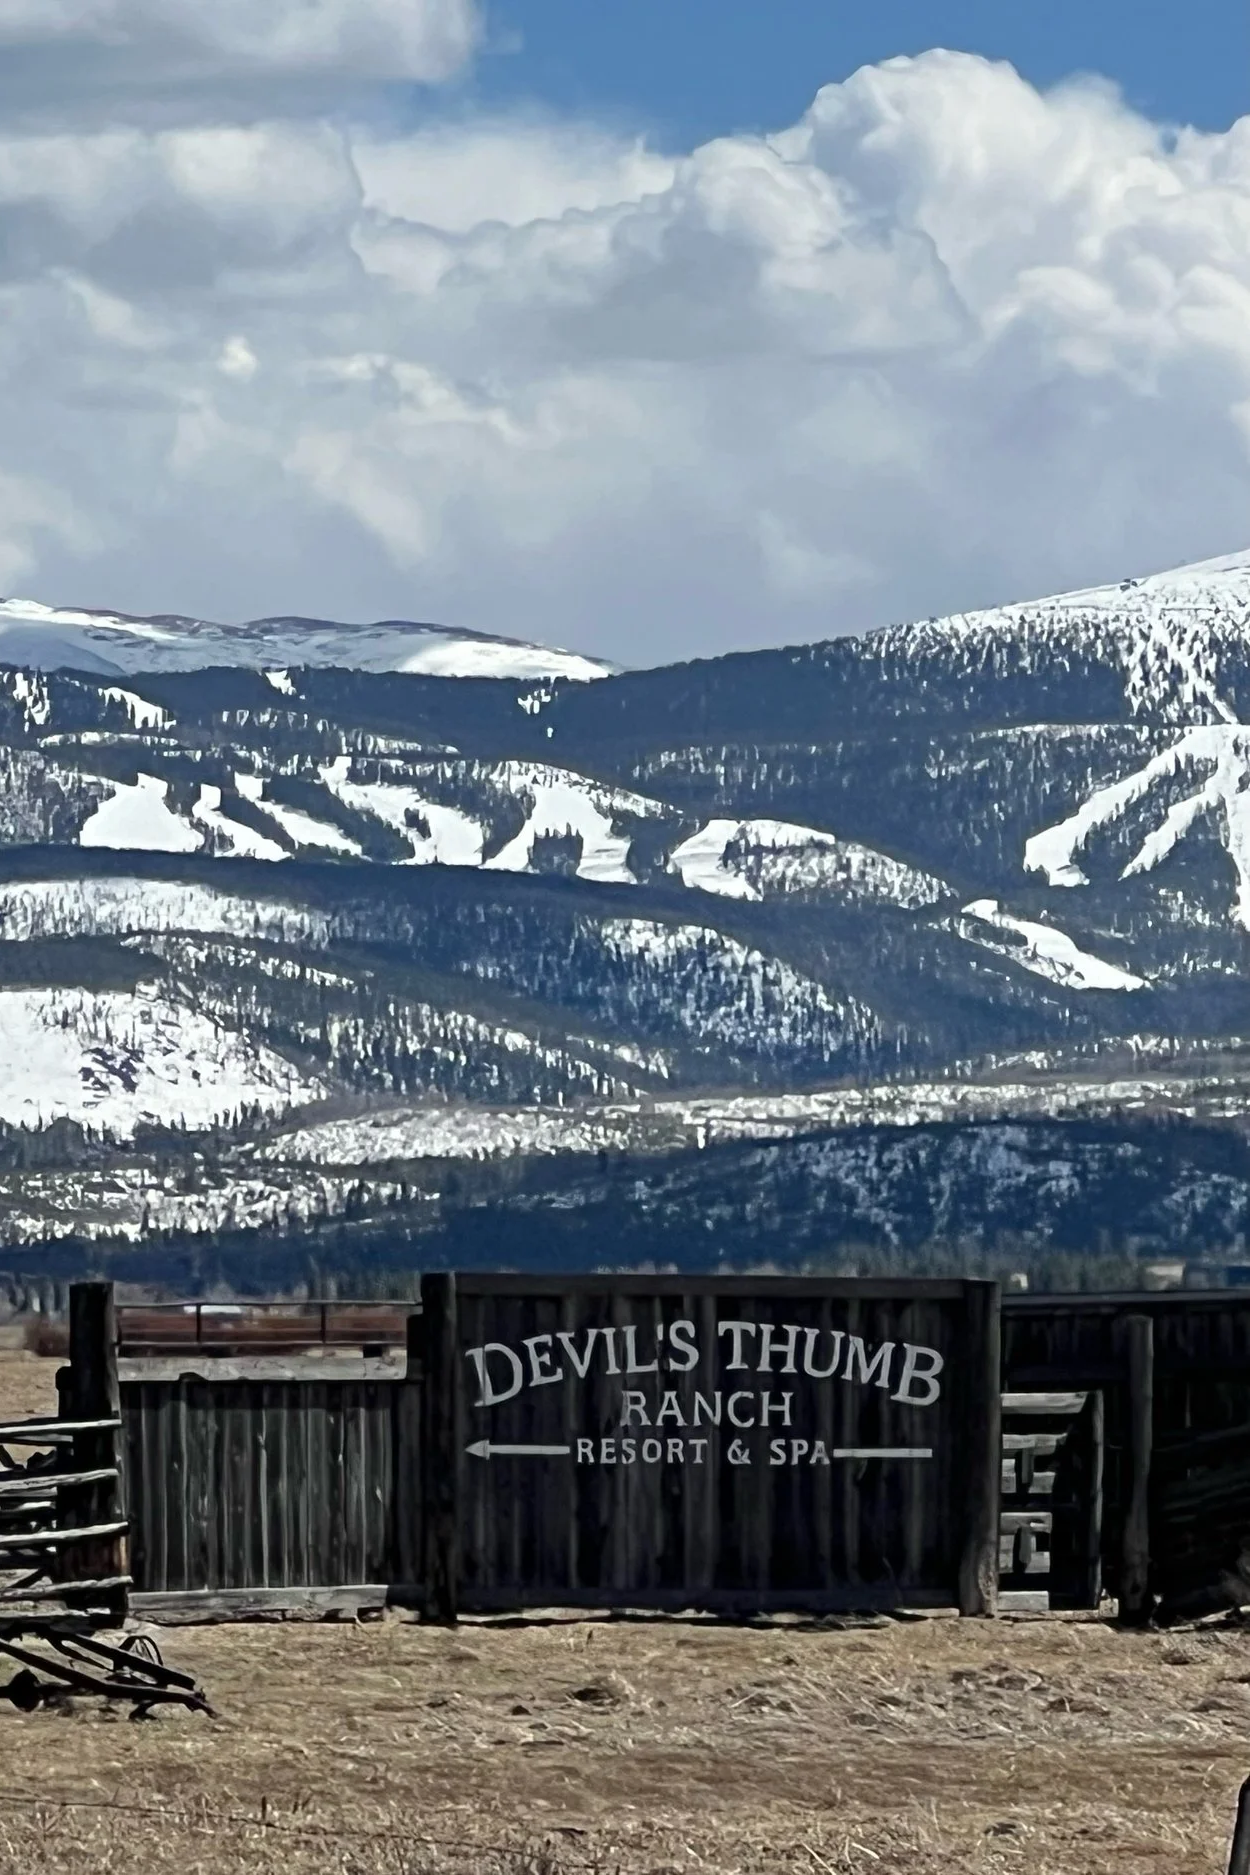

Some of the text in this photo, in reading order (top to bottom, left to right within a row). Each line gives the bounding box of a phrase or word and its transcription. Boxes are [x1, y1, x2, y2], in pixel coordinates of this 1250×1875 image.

[464, 1320, 944, 1407] DEVIL'S THUMB
[619, 1390, 794, 1428] RANCH
[576, 1437, 831, 1465] RESORT & SPA
